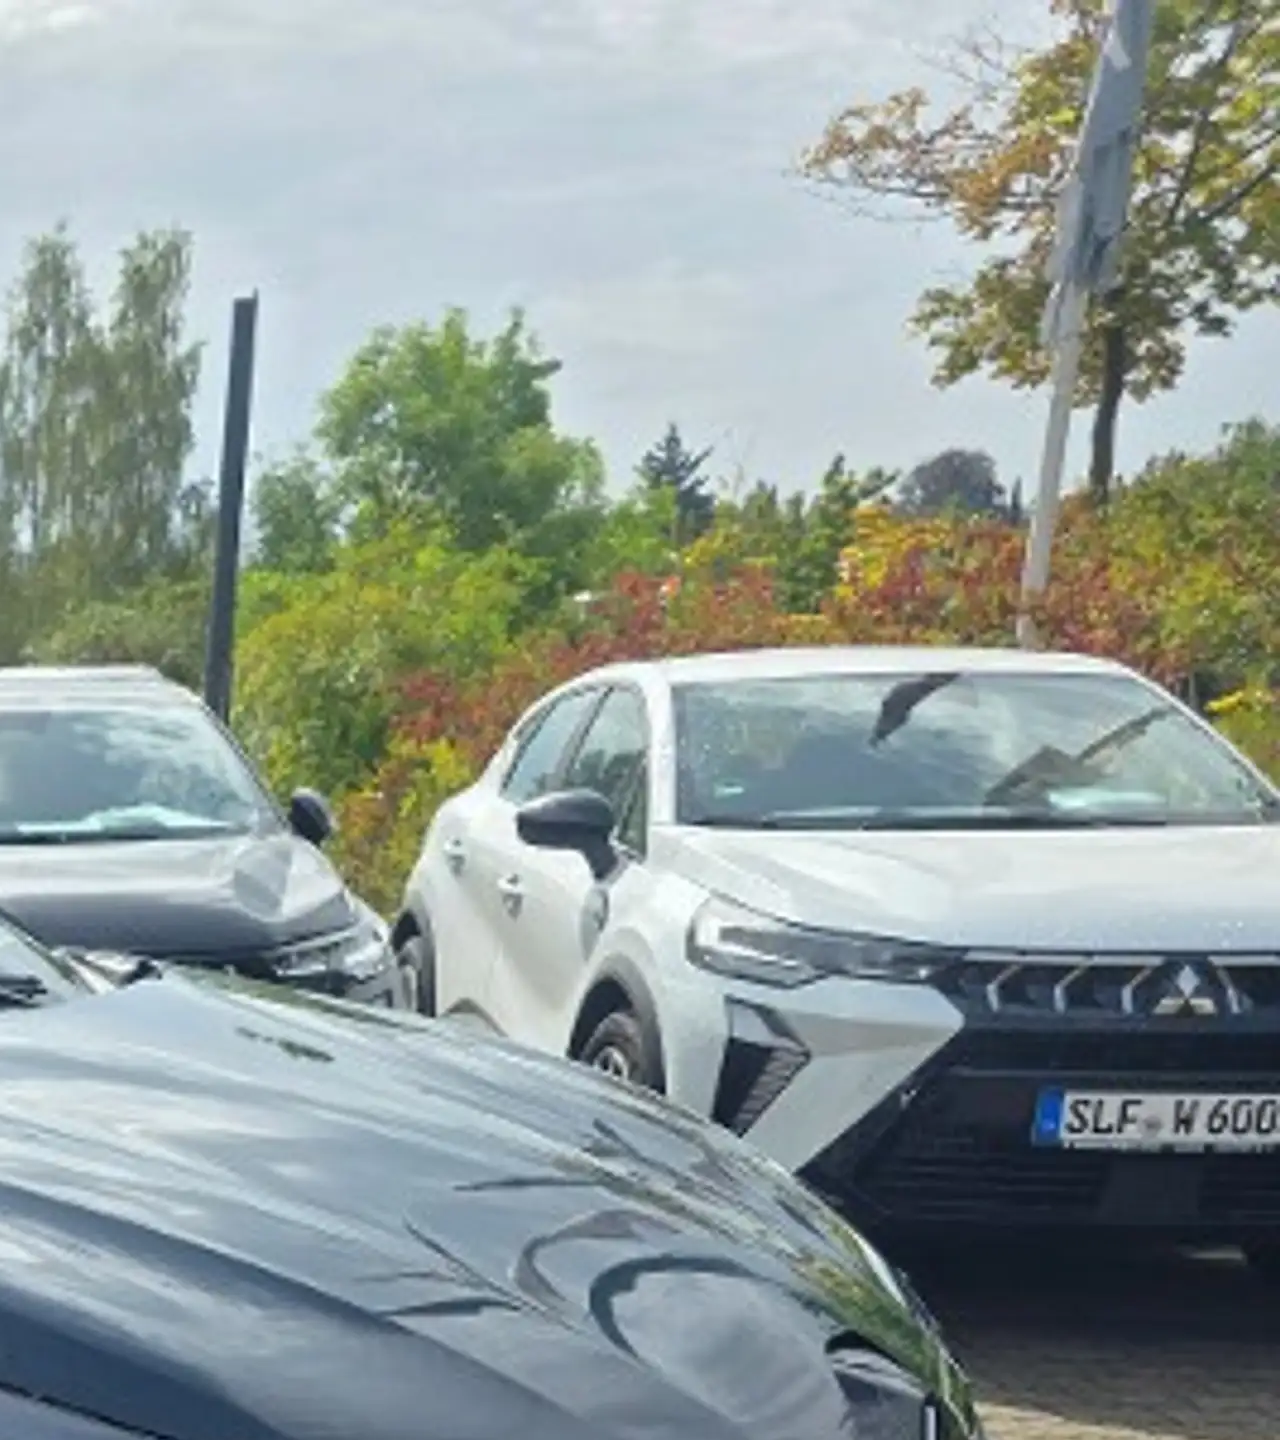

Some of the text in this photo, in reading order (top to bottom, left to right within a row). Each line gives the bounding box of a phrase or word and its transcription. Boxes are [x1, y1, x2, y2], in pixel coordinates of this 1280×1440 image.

[1066, 1099, 1277, 1134] SLF W 600
